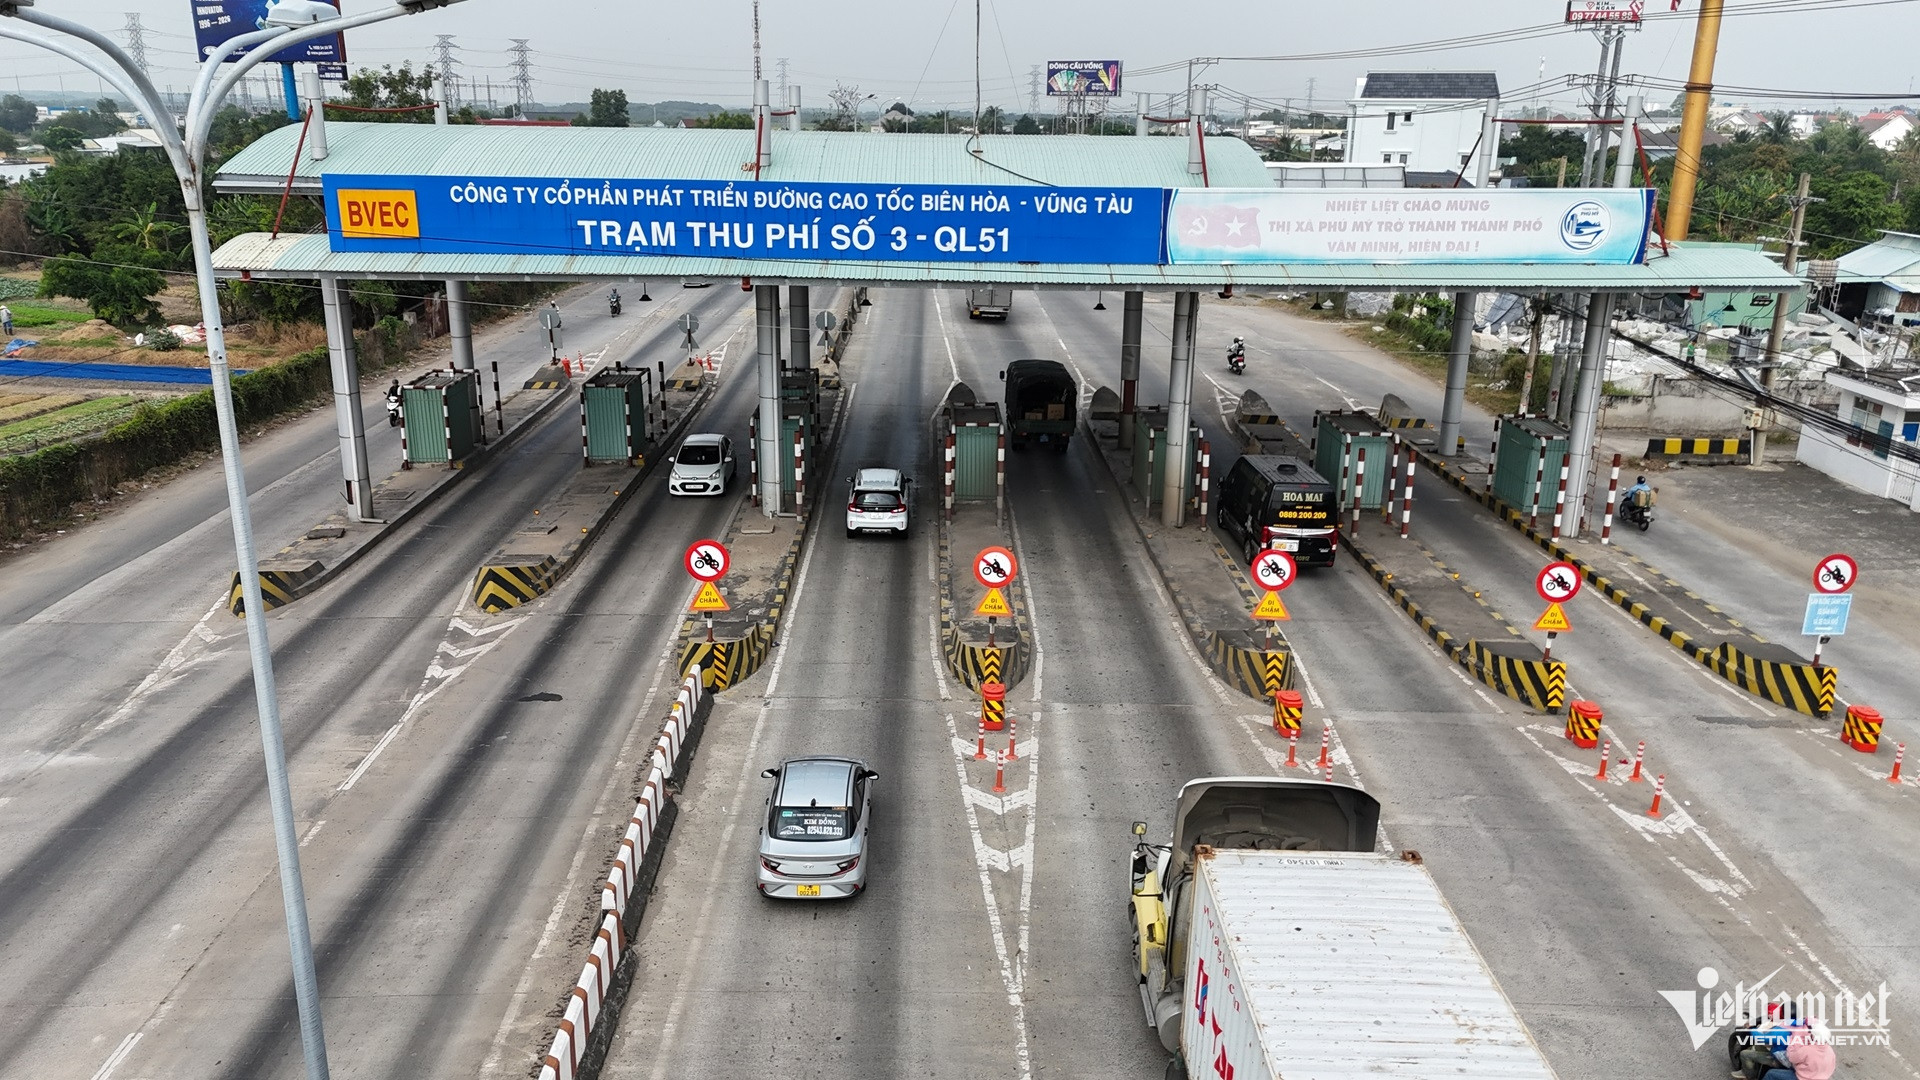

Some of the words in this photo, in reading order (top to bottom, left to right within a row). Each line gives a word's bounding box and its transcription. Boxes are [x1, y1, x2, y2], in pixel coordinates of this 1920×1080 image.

[450, 181, 507, 204] CÔNG
[513, 186, 539, 204] TY
[633, 184, 684, 207] PHÁT
[690, 181, 748, 208] TRIỂN
[754, 186, 822, 210] ĐƯỜNG
[828, 192, 868, 210] CAO
[876, 187, 914, 212] TỐC
[921, 190, 964, 212] BIÊN
[971, 192, 1010, 212] HÒA
[1034, 193, 1087, 214] VŨNG
[1094, 192, 1133, 214] TÀU
[1326, 198, 1368, 214] NHIỆT
[1403, 198, 1442, 212] CHÀO
[347, 201, 409, 228] BVEC
[577, 219, 676, 251] TRẠM
[686, 221, 754, 248] THU
[766, 216, 822, 249] PHÍ
[830, 215, 876, 251] SỐ
[890, 226, 907, 251] 3
[934, 226, 1009, 252] QL51
[1268, 221, 1291, 235] THỊ
[1318, 218, 1348, 232] PHÚ
[1408, 218, 1456, 232] THÀNH
[1461, 218, 1508, 232] THÀNH
[1512, 217, 1543, 232] PHỐ
[1282, 492, 1304, 502] HOA
[1305, 492, 1324, 502] MAI
